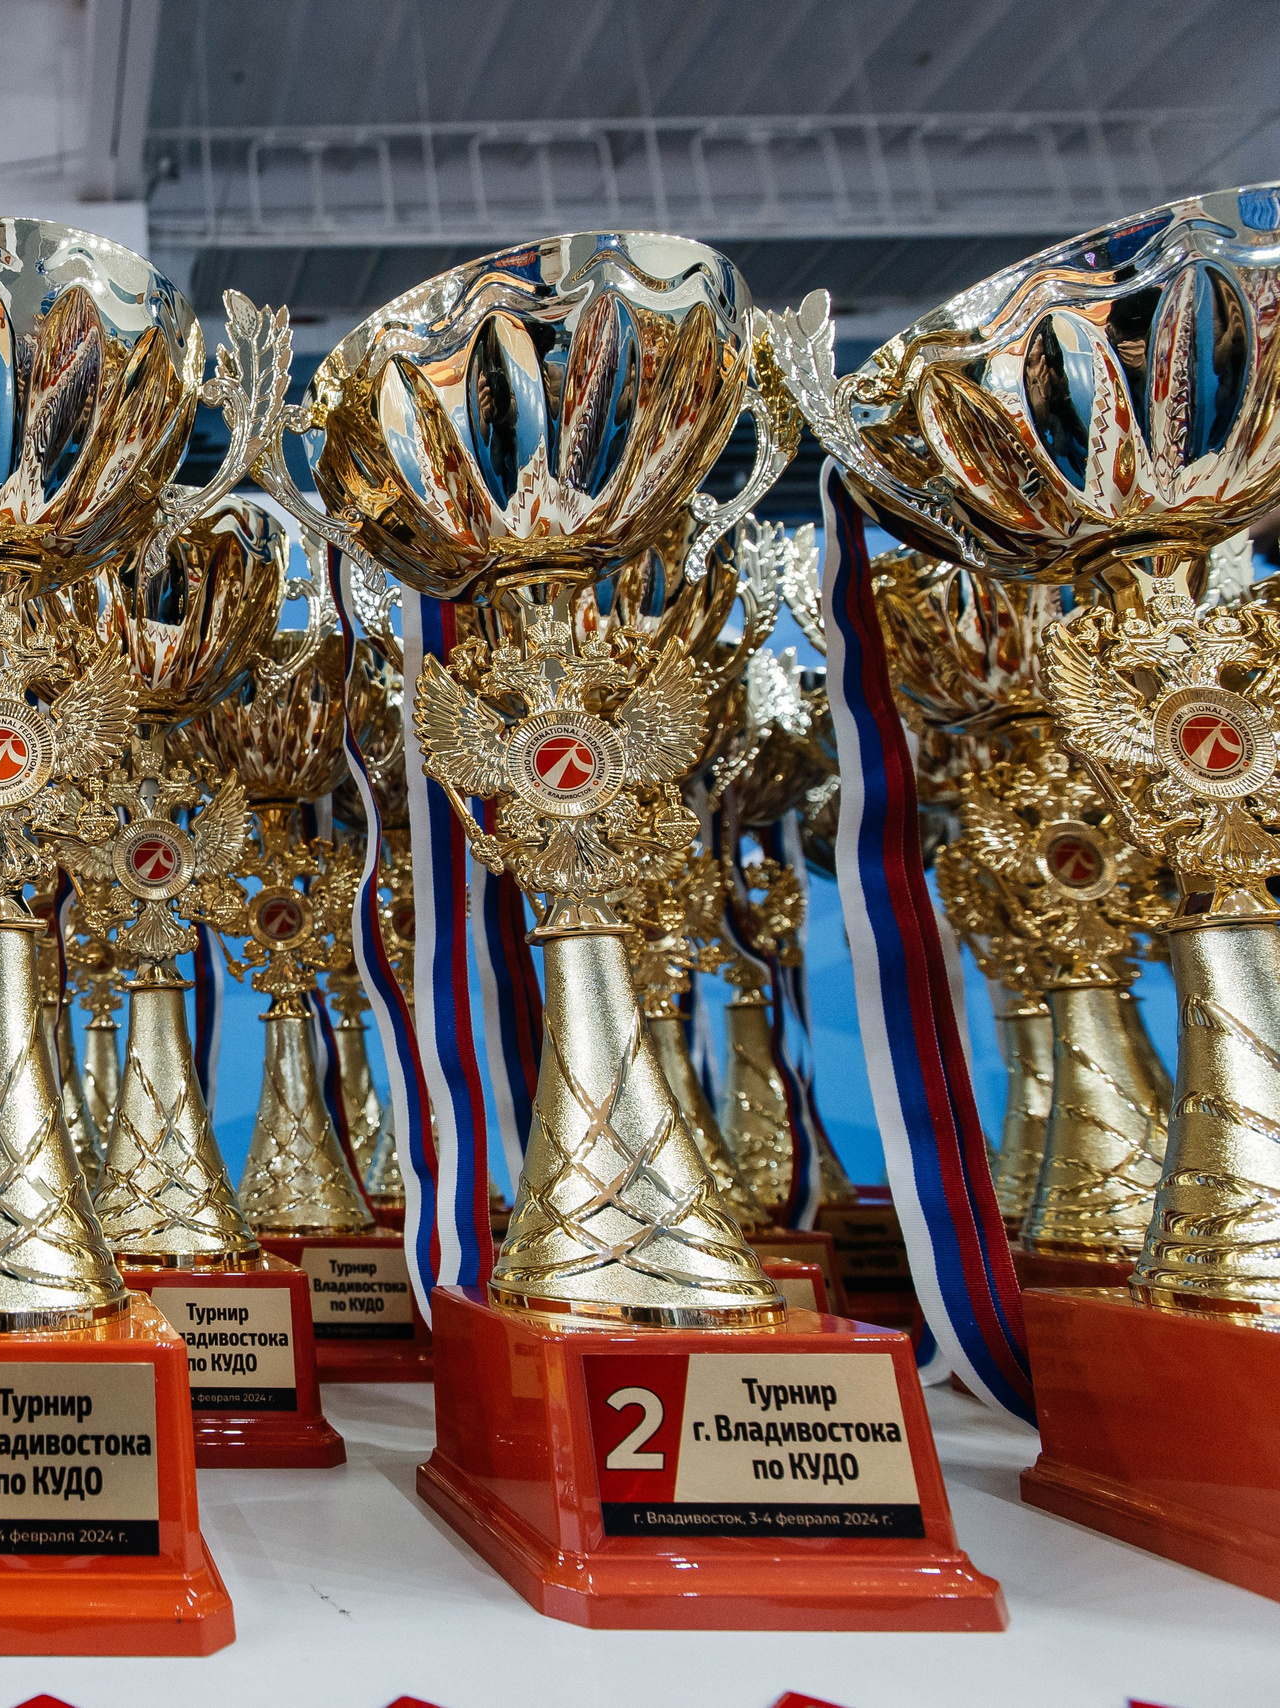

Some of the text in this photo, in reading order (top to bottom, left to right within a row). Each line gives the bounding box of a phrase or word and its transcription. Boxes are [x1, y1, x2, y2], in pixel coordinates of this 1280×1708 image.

[1170, 705, 1254, 763] KUDO INTERNATIONAL FEDERATION
[18, 724, 39, 773] FEDERATION
[523, 727, 606, 783] KUDO INTERNATIONAL FEDERATION
[329, 1258, 377, 1278] Турнир
[312, 1278, 407, 1295] Владивостока
[186, 1302, 249, 1325] Турнир
[330, 1297, 385, 1315] по КУДО
[179, 1332, 289, 1350] адивостока
[187, 1353, 258, 1376] по КУДО
[197, 1393, 241, 1404] февраля
[242, 1393, 267, 1403] 2024
[741, 1377, 837, 1411] Турнир
[605, 1385, 665, 1471] 2
[693, 1414, 902, 1447] г. Владивостока
[752, 1451, 860, 1486] по КУДО
[32, 1465, 103, 1501] КУДО
[634, 1510, 893, 1528] г. Владивосток, 3-4 февраля 2024 г.
[9, 1528, 75, 1545] февраля
[79, 1528, 114, 1543] 2024
[119, 1531, 129, 1544] г.
